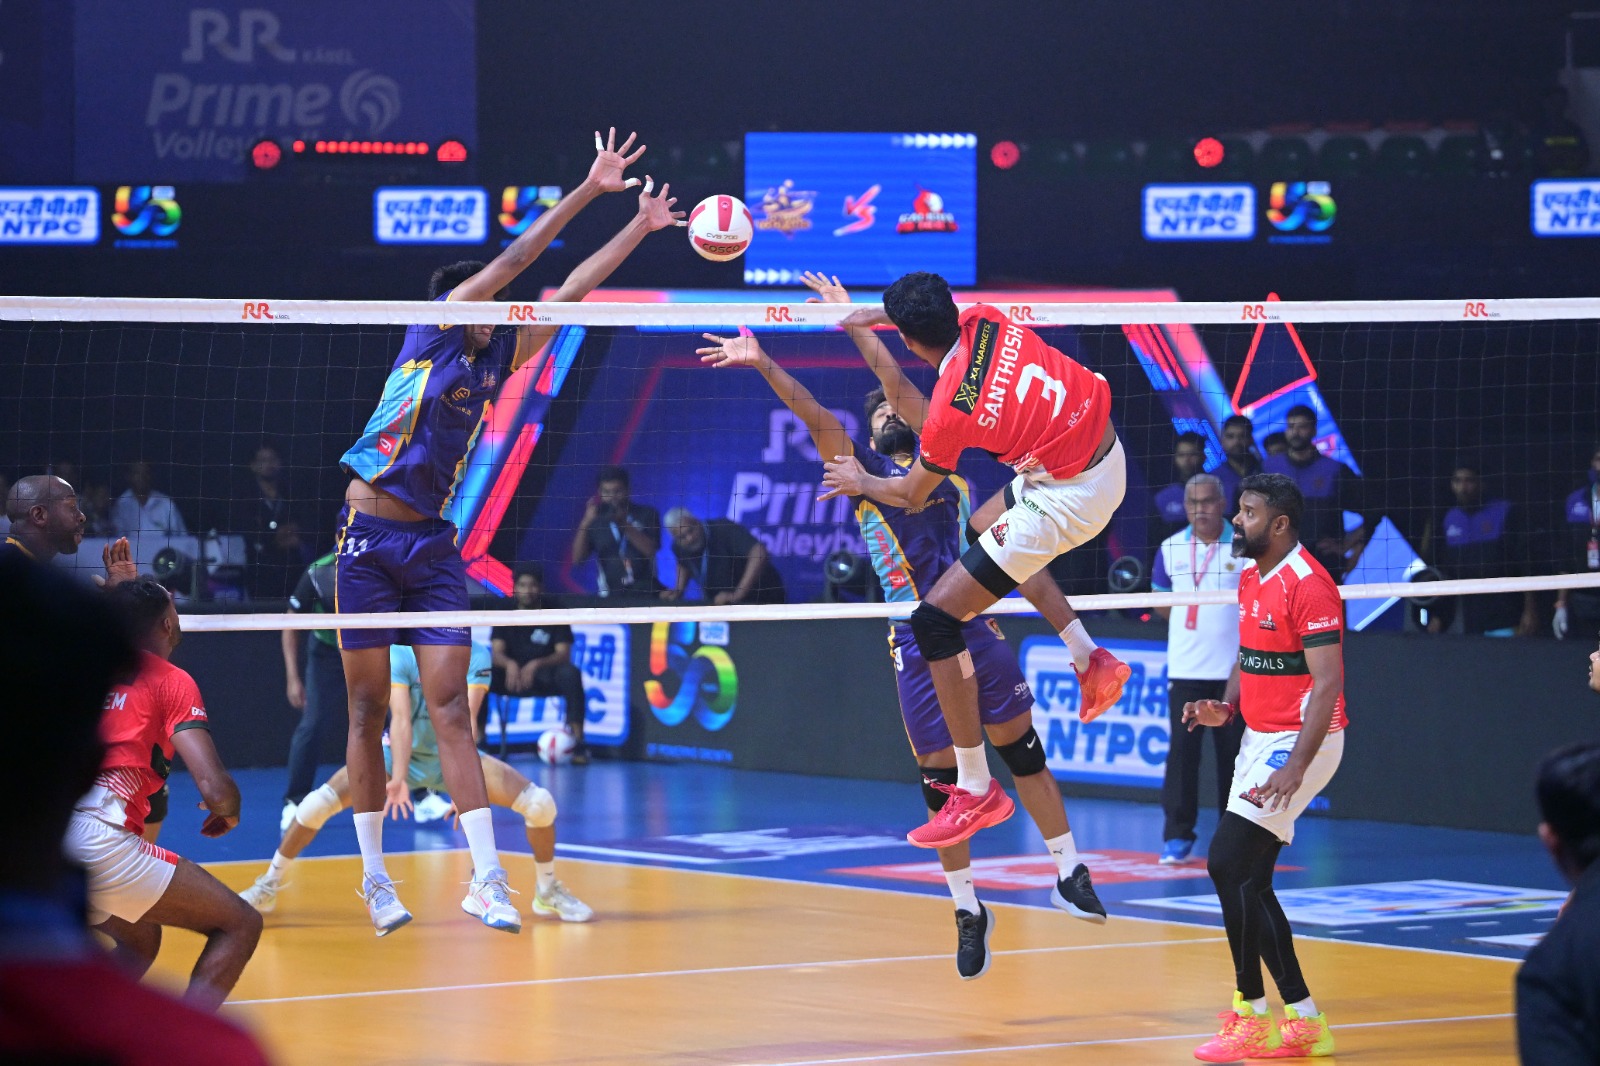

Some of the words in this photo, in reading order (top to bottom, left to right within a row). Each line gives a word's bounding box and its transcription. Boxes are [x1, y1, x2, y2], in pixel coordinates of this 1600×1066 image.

[145, 73, 332, 127] Prime
[4, 220, 82, 235] NTPC
[392, 220, 470, 234] NTPC
[1161, 216, 1237, 231] NTPC
[702, 243, 740, 253] COSCO
[242, 303, 273, 319] RR
[507, 305, 537, 321] RR
[975, 322, 991, 366] MARKETS
[970, 367, 981, 380] XA
[978, 325, 1024, 430] SANTHOSH
[1015, 363, 1067, 421] 3
[1046, 718, 1169, 765] NTPC
